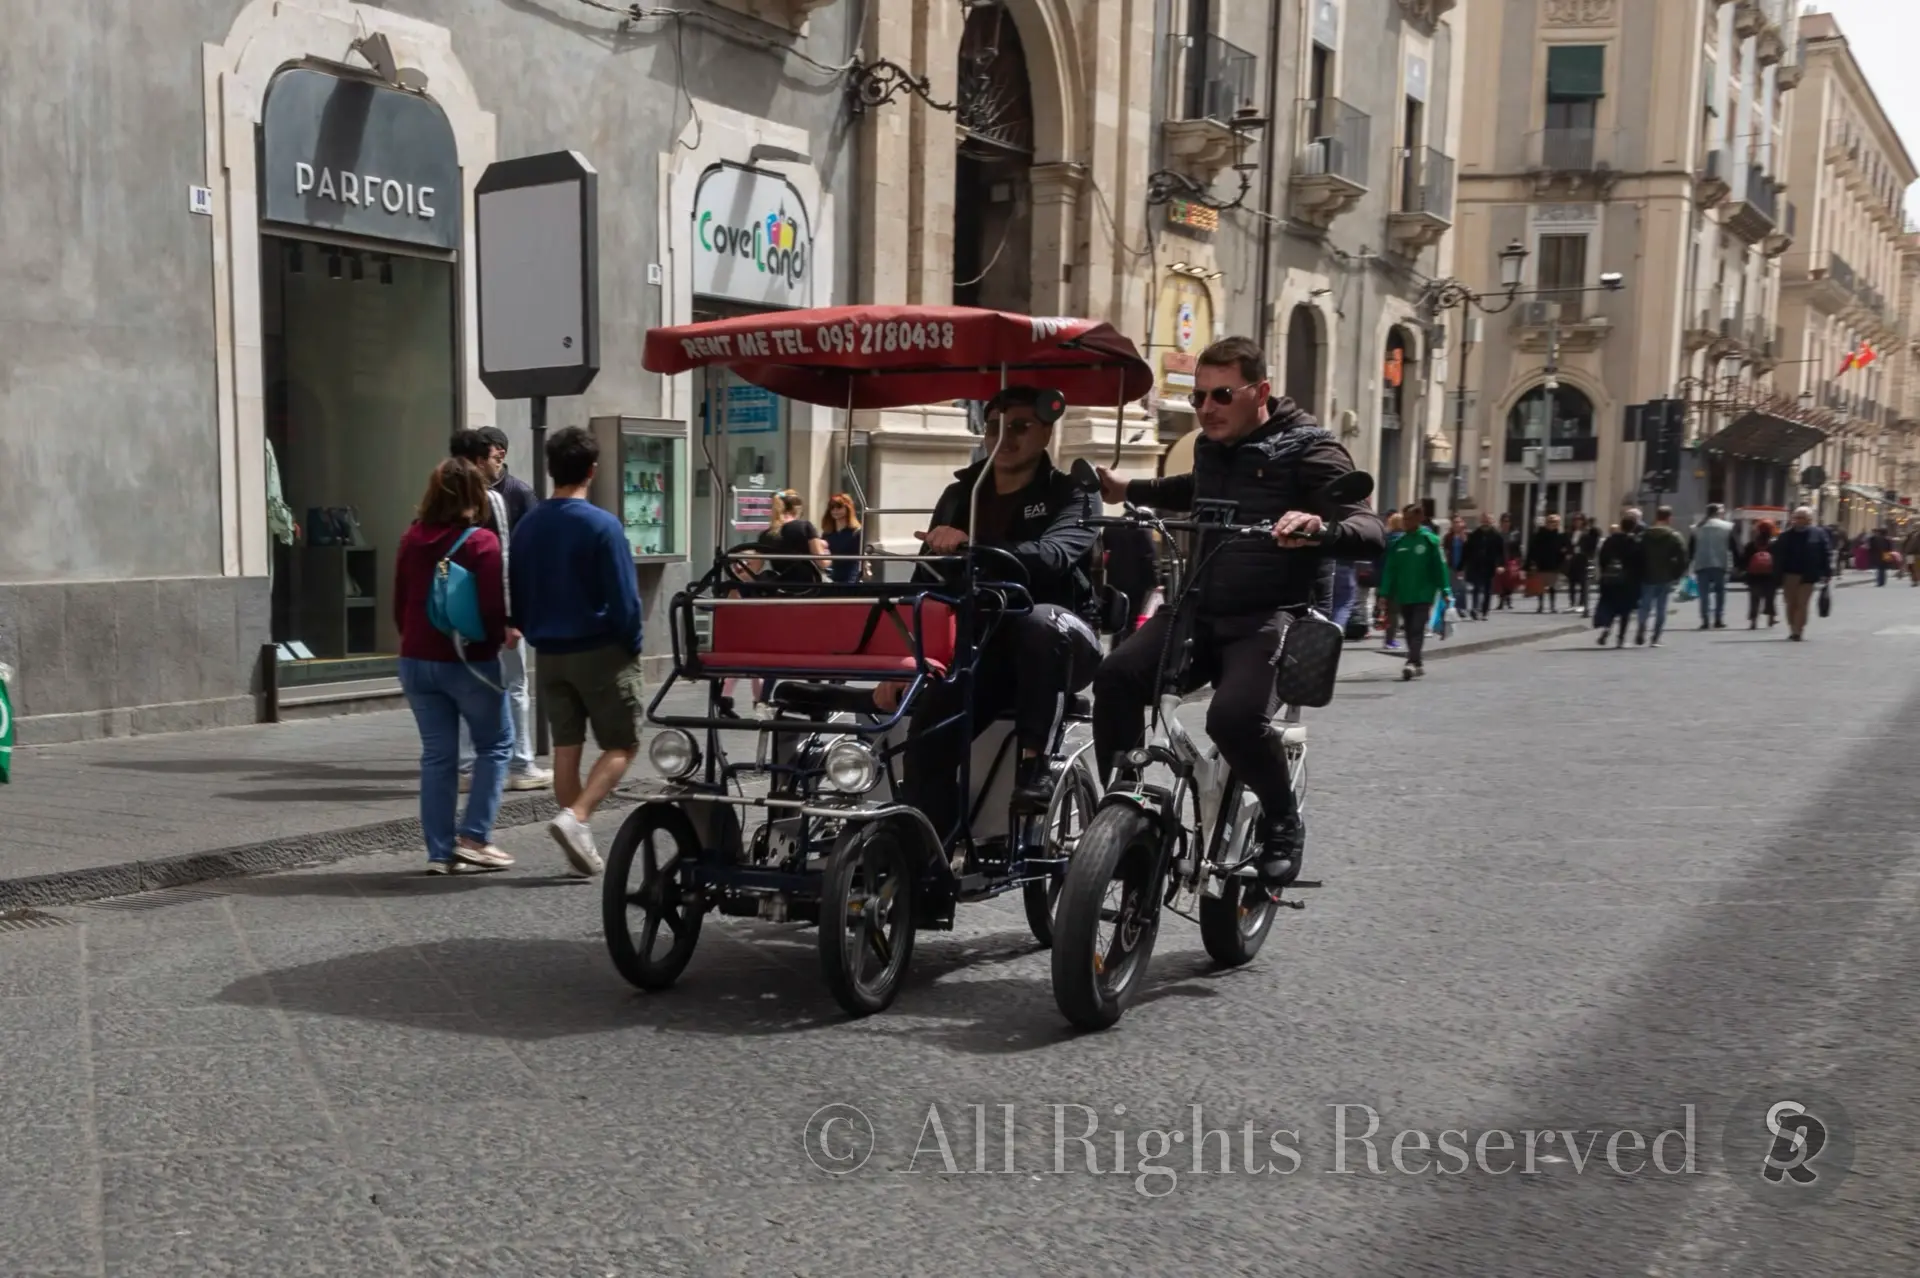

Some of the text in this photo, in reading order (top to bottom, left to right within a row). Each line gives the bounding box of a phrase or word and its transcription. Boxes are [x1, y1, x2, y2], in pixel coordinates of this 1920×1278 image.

[296, 161, 436, 219] PARFOIS
[680, 321, 954, 359] RENT ME TEL. 095 2180438
